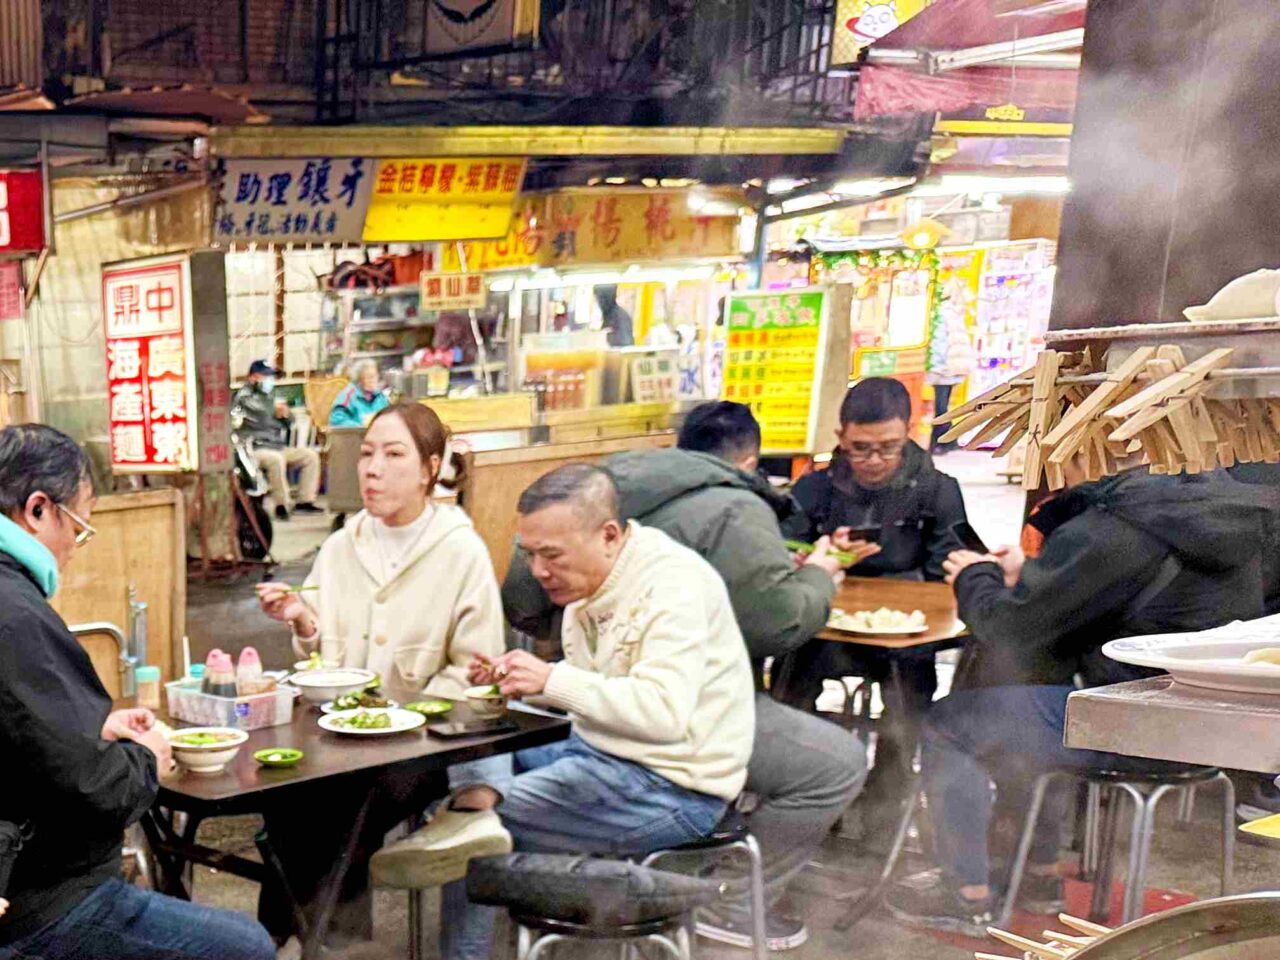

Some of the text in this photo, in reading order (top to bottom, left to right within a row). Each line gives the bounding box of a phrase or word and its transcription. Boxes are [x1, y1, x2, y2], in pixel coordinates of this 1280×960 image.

[107, 338, 147, 463] 海產麵
[147, 336, 187, 463] 廣東粥
